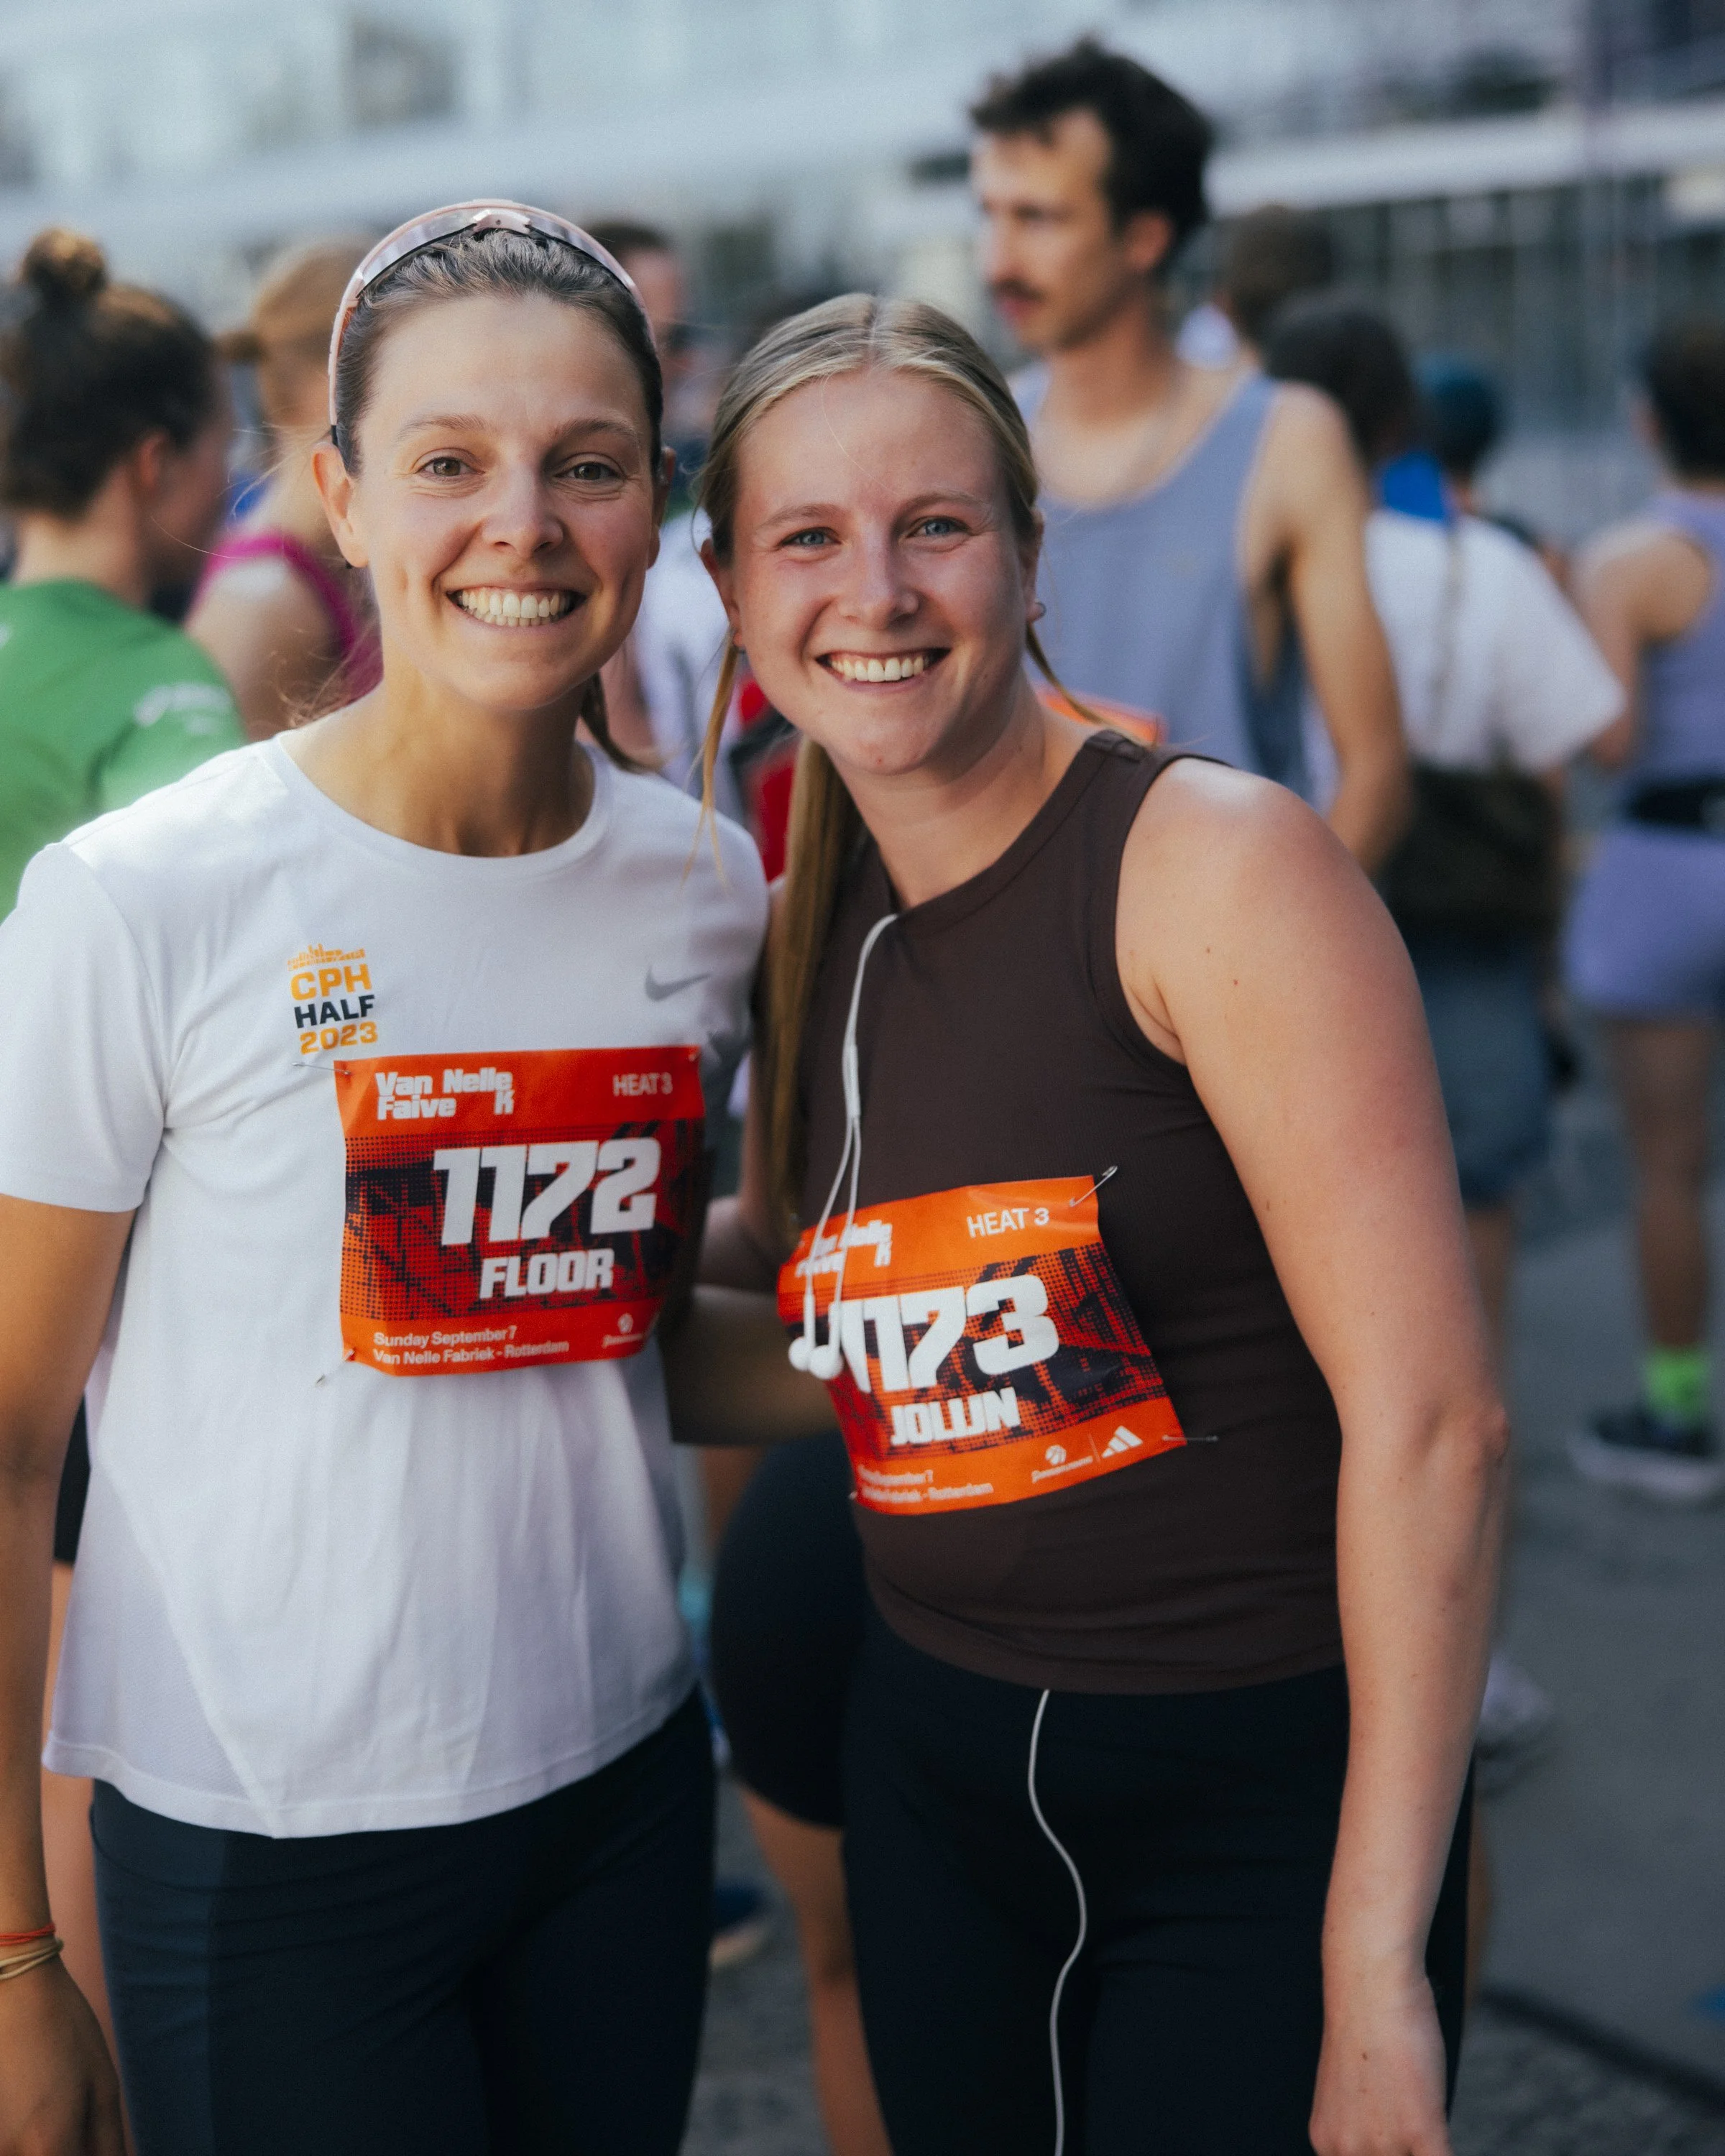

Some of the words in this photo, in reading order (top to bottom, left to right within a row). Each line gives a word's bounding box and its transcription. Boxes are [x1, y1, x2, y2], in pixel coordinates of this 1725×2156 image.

[290, 964, 372, 1000] CPH
[294, 995, 375, 1028] HALF
[300, 1021, 378, 1055] 2023
[375, 1072, 433, 1096] Van
[442, 1067, 513, 1094] Nelle
[612, 1073, 659, 1097] HEAT
[661, 1072, 673, 1095] 3
[377, 1094, 457, 1120] Faive
[494, 1089, 515, 1115] K
[433, 1137, 661, 1245] 1172
[967, 1208, 1030, 1238] HEAT
[1034, 1207, 1049, 1226] 3
[479, 1248, 615, 1299] FLOOR
[374, 1332, 430, 1349] Sunday
[432, 1327, 507, 1347] September
[508, 1325, 518, 1340] 7
[373, 1349, 400, 1365] Van
[403, 1350, 441, 1364] Nelle
[443, 1348, 495, 1363] Fabriek
[505, 1340, 570, 1358] Rotterdam
